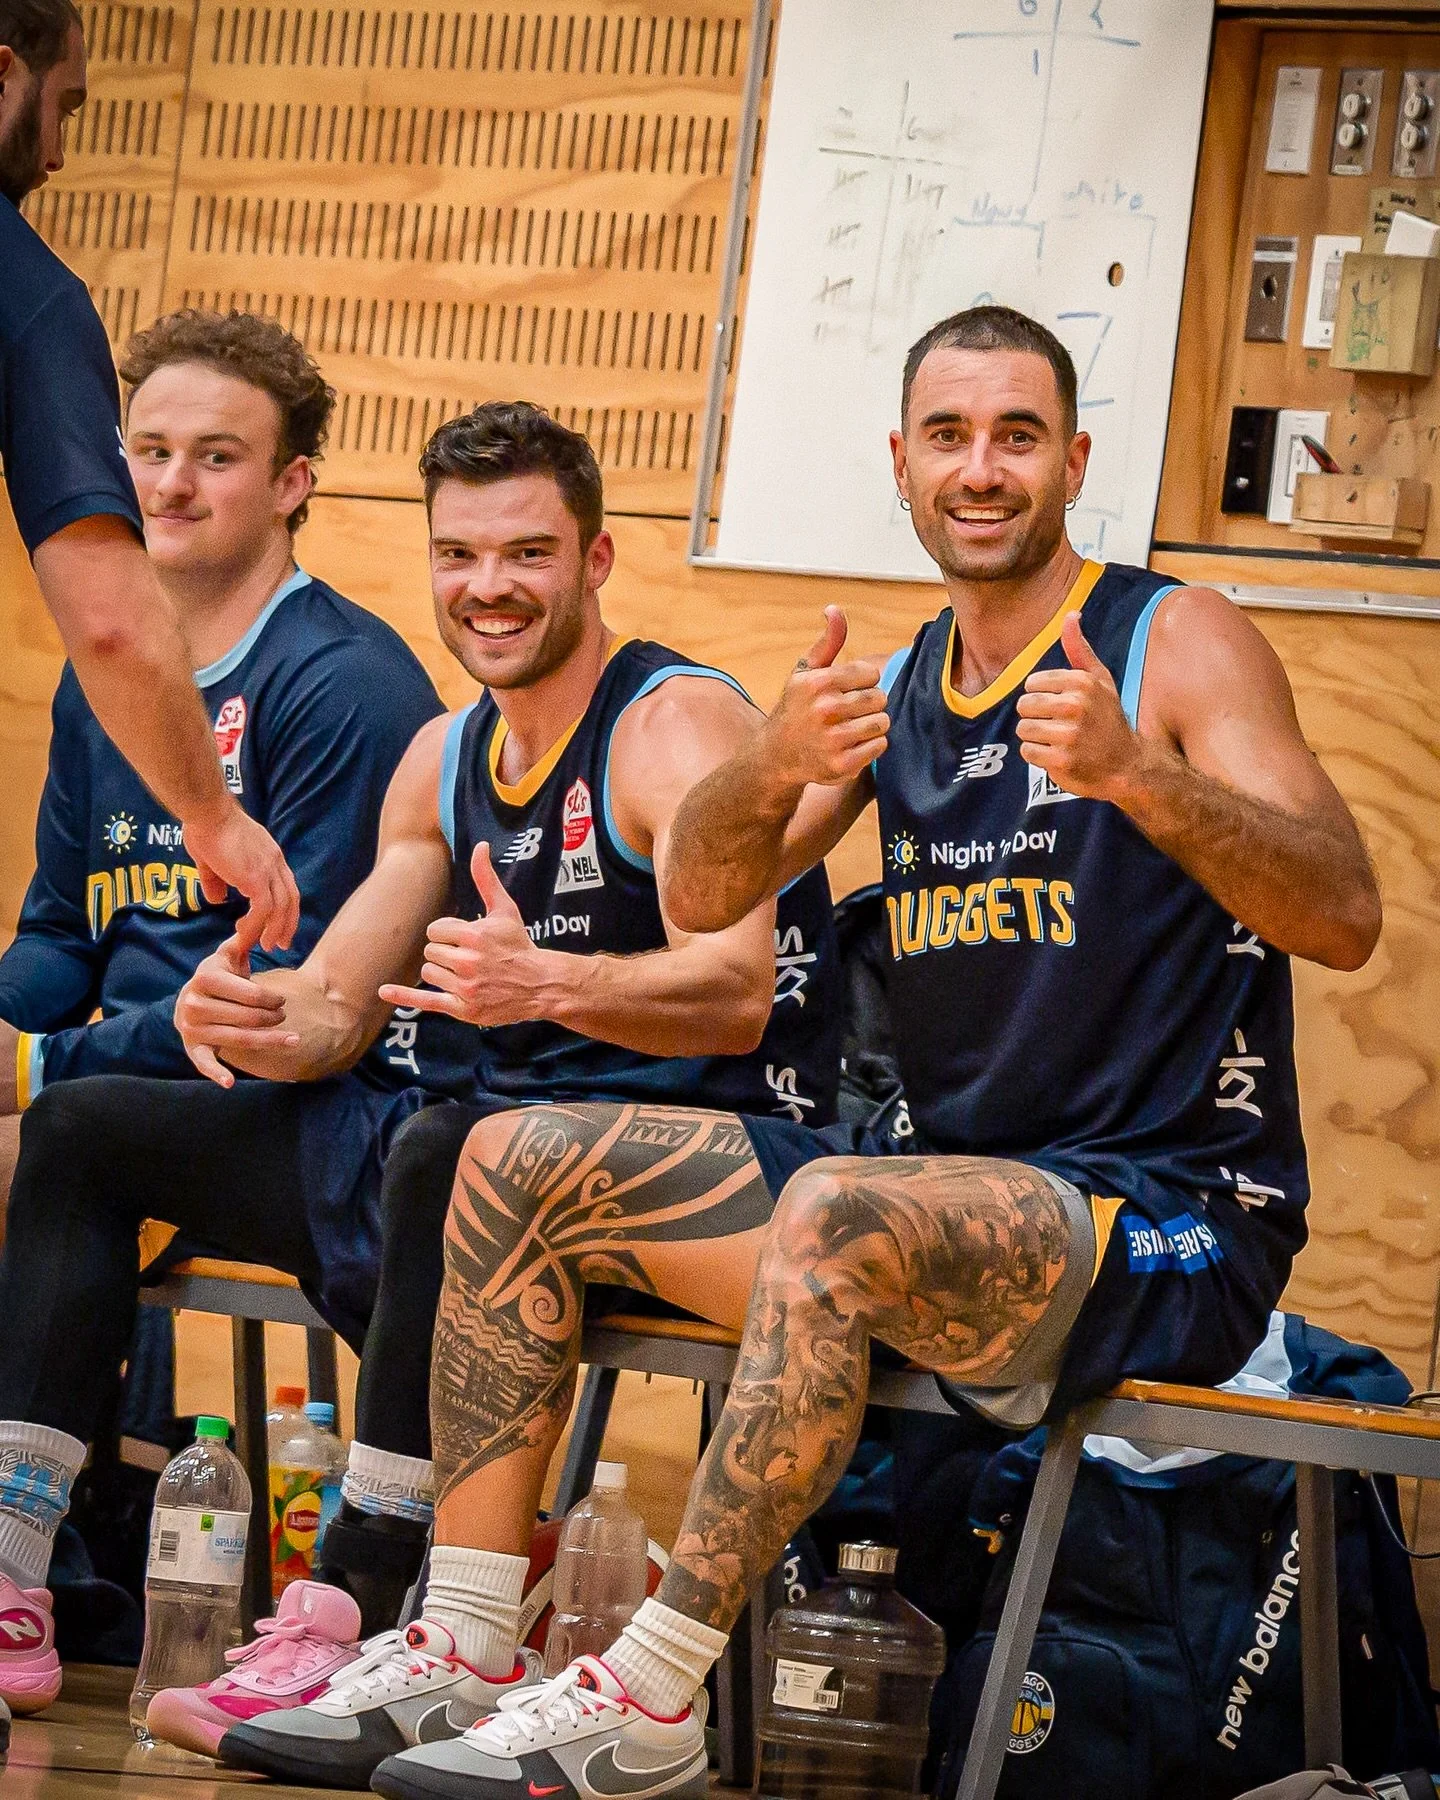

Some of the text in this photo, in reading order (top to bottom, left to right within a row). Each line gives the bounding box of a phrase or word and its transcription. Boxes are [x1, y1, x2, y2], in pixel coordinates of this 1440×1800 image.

[224, 764, 240, 781] BL
[931, 840, 995, 870] Night
[1013, 829, 1058, 853] Day
[571, 855, 598, 877] NBL
[552, 914, 591, 937] Day
[1217, 1675, 1253, 1750] new
